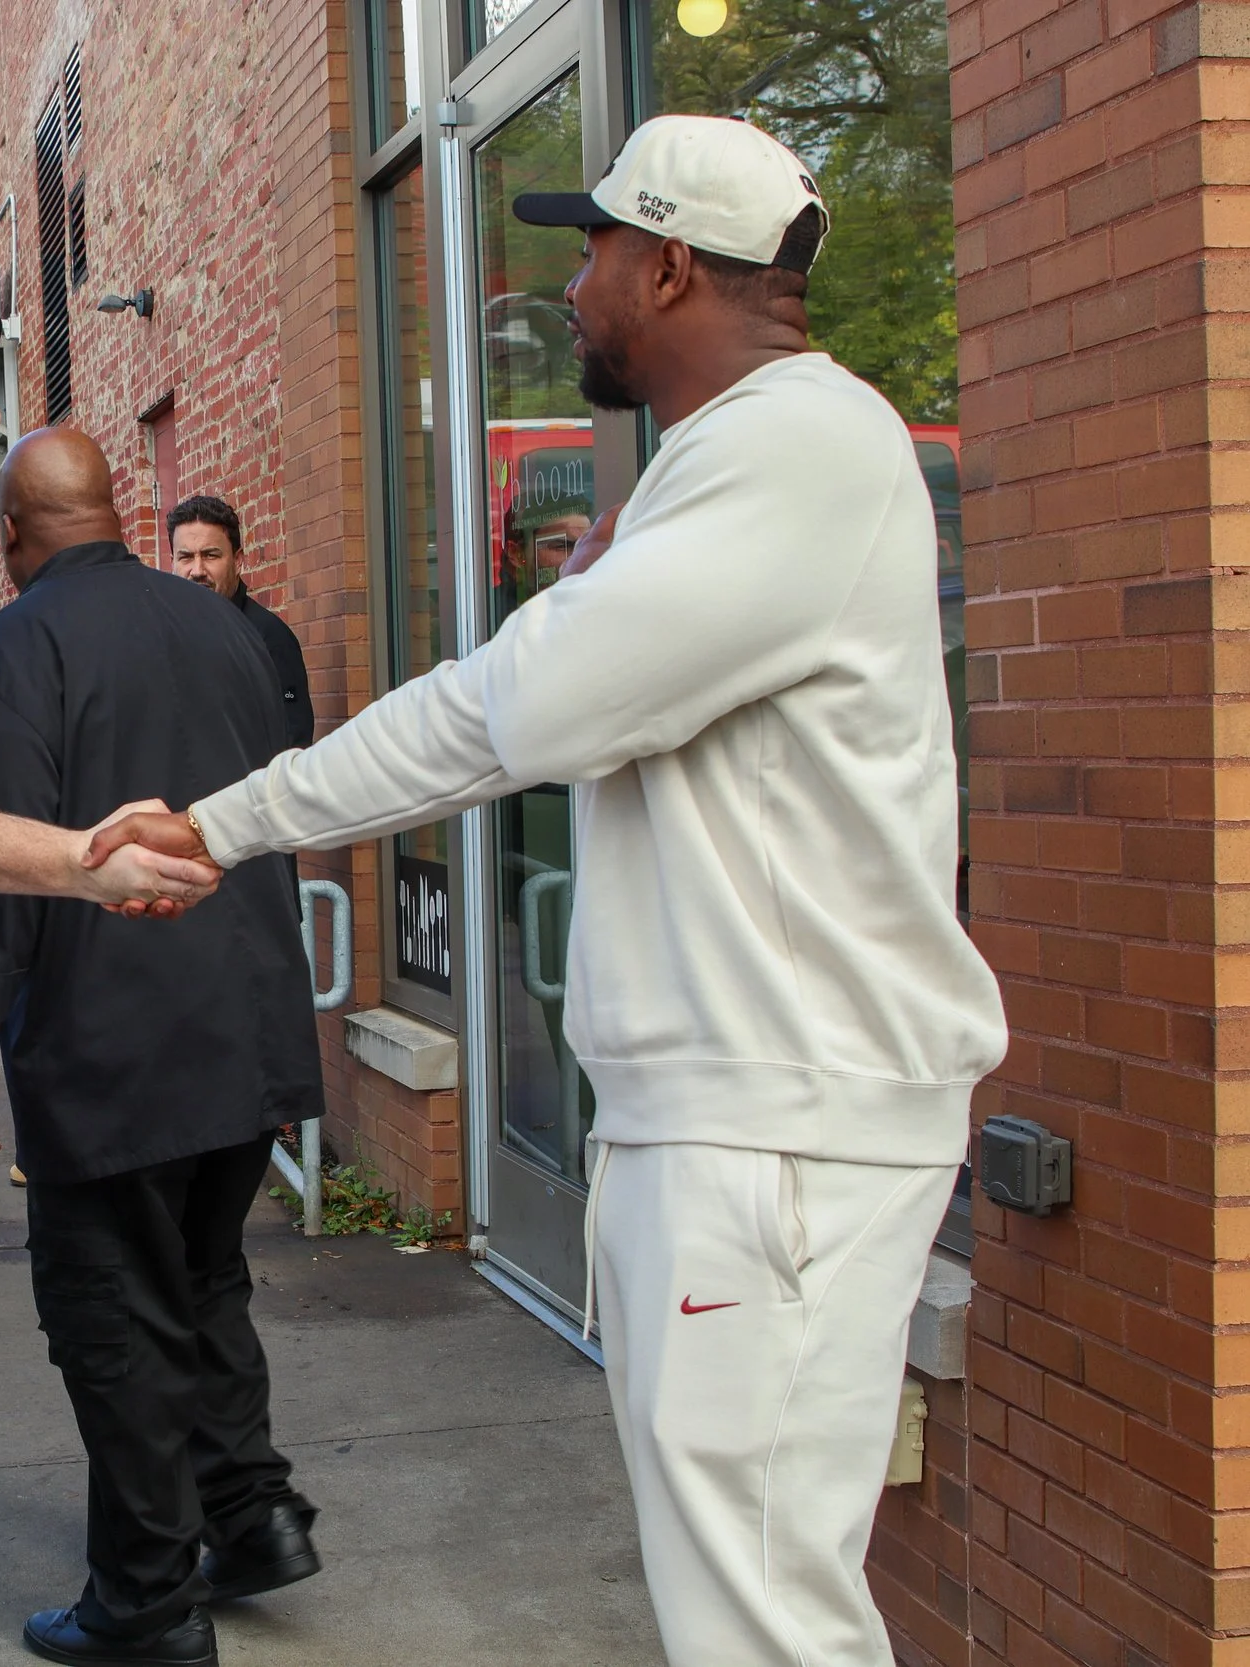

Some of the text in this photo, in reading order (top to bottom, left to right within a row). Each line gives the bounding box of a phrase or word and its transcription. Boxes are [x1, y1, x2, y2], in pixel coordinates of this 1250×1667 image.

[637, 190, 677, 215] 10:43-45
[637, 203, 666, 224] MARK
[509, 455, 585, 514] bloom
